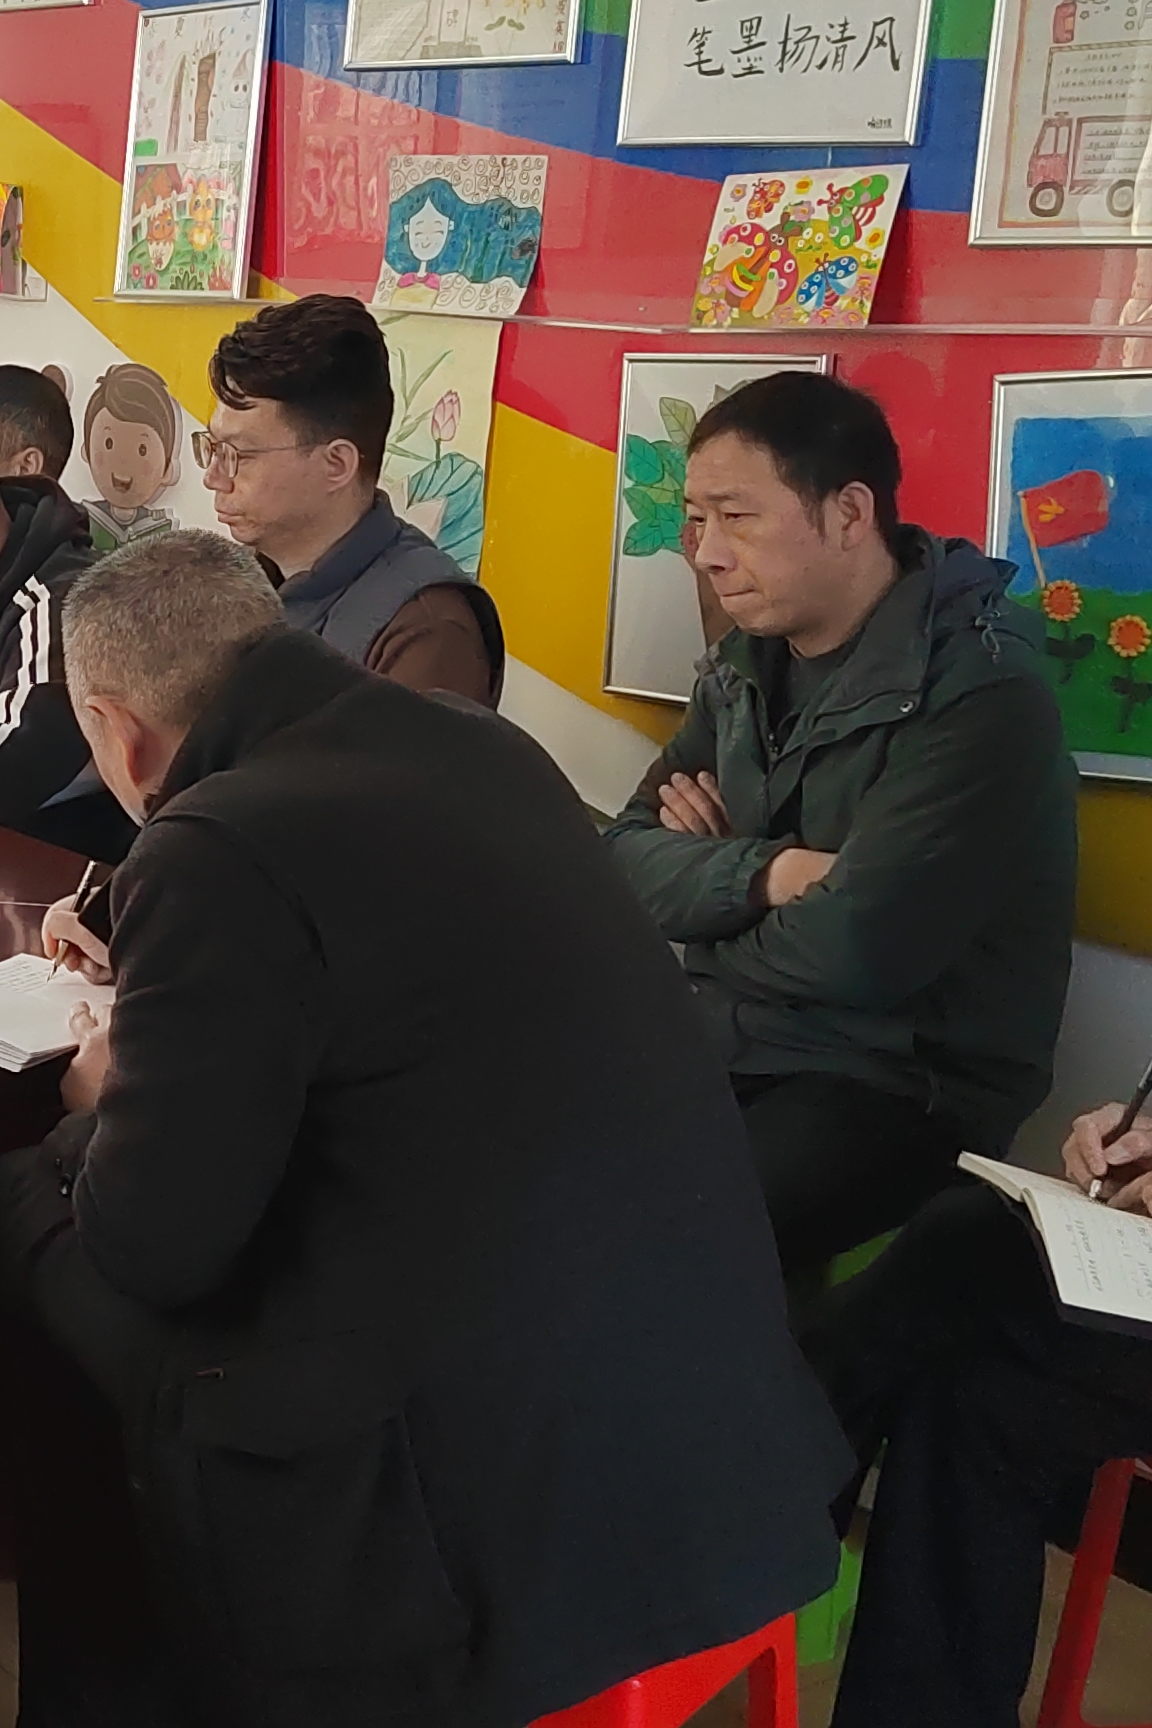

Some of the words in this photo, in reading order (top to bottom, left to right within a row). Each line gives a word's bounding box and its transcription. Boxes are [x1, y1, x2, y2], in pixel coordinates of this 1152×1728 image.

[684, 14, 900, 78] 笔墨扬清风
